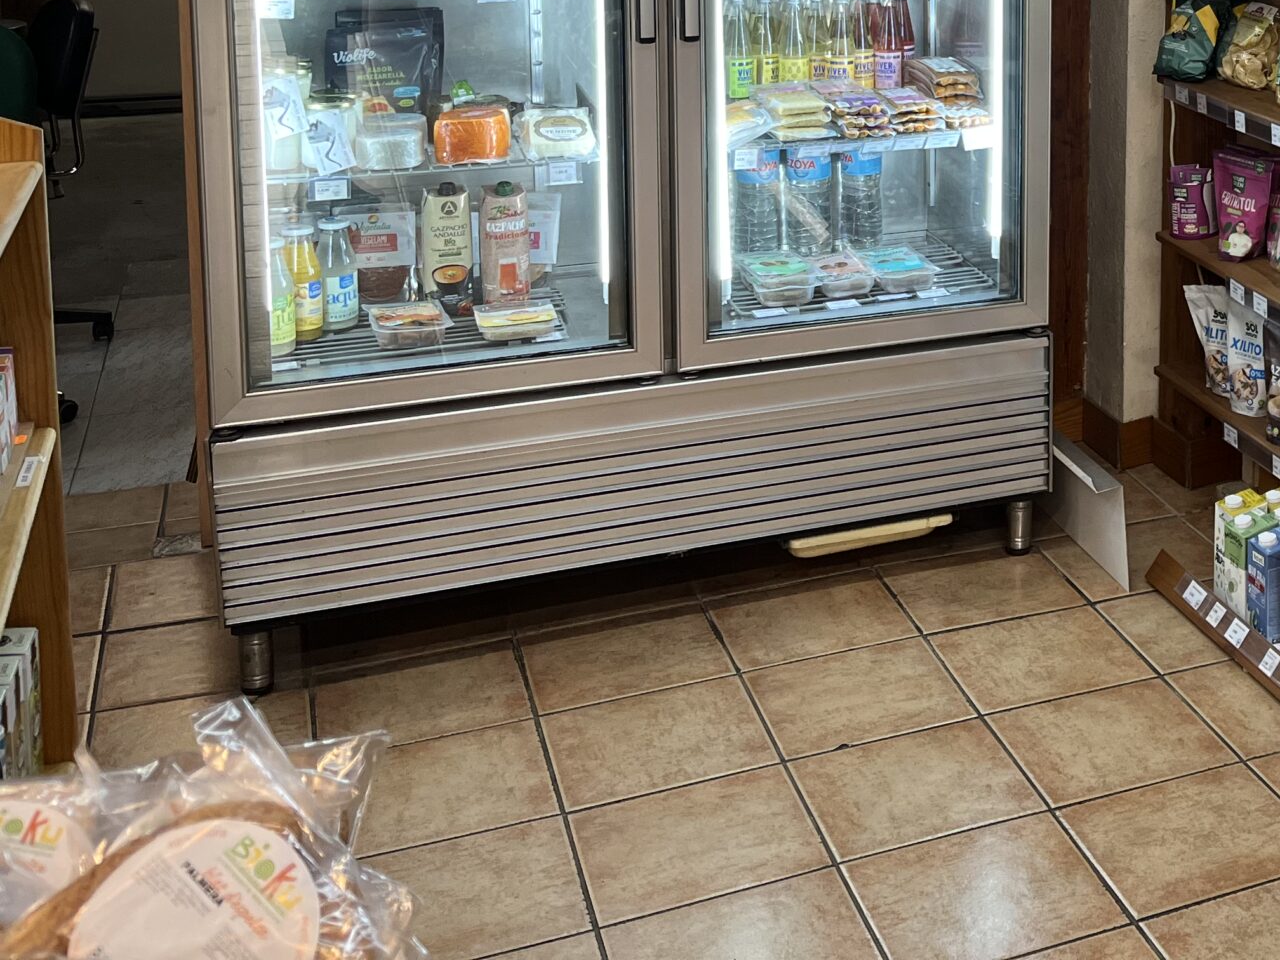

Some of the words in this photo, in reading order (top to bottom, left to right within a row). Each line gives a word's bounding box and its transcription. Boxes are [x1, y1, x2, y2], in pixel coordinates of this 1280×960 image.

[332, 47, 377, 66] Violife
[1230, 337, 1263, 356] XILITO
[181, 860, 224, 907] PALMERA
